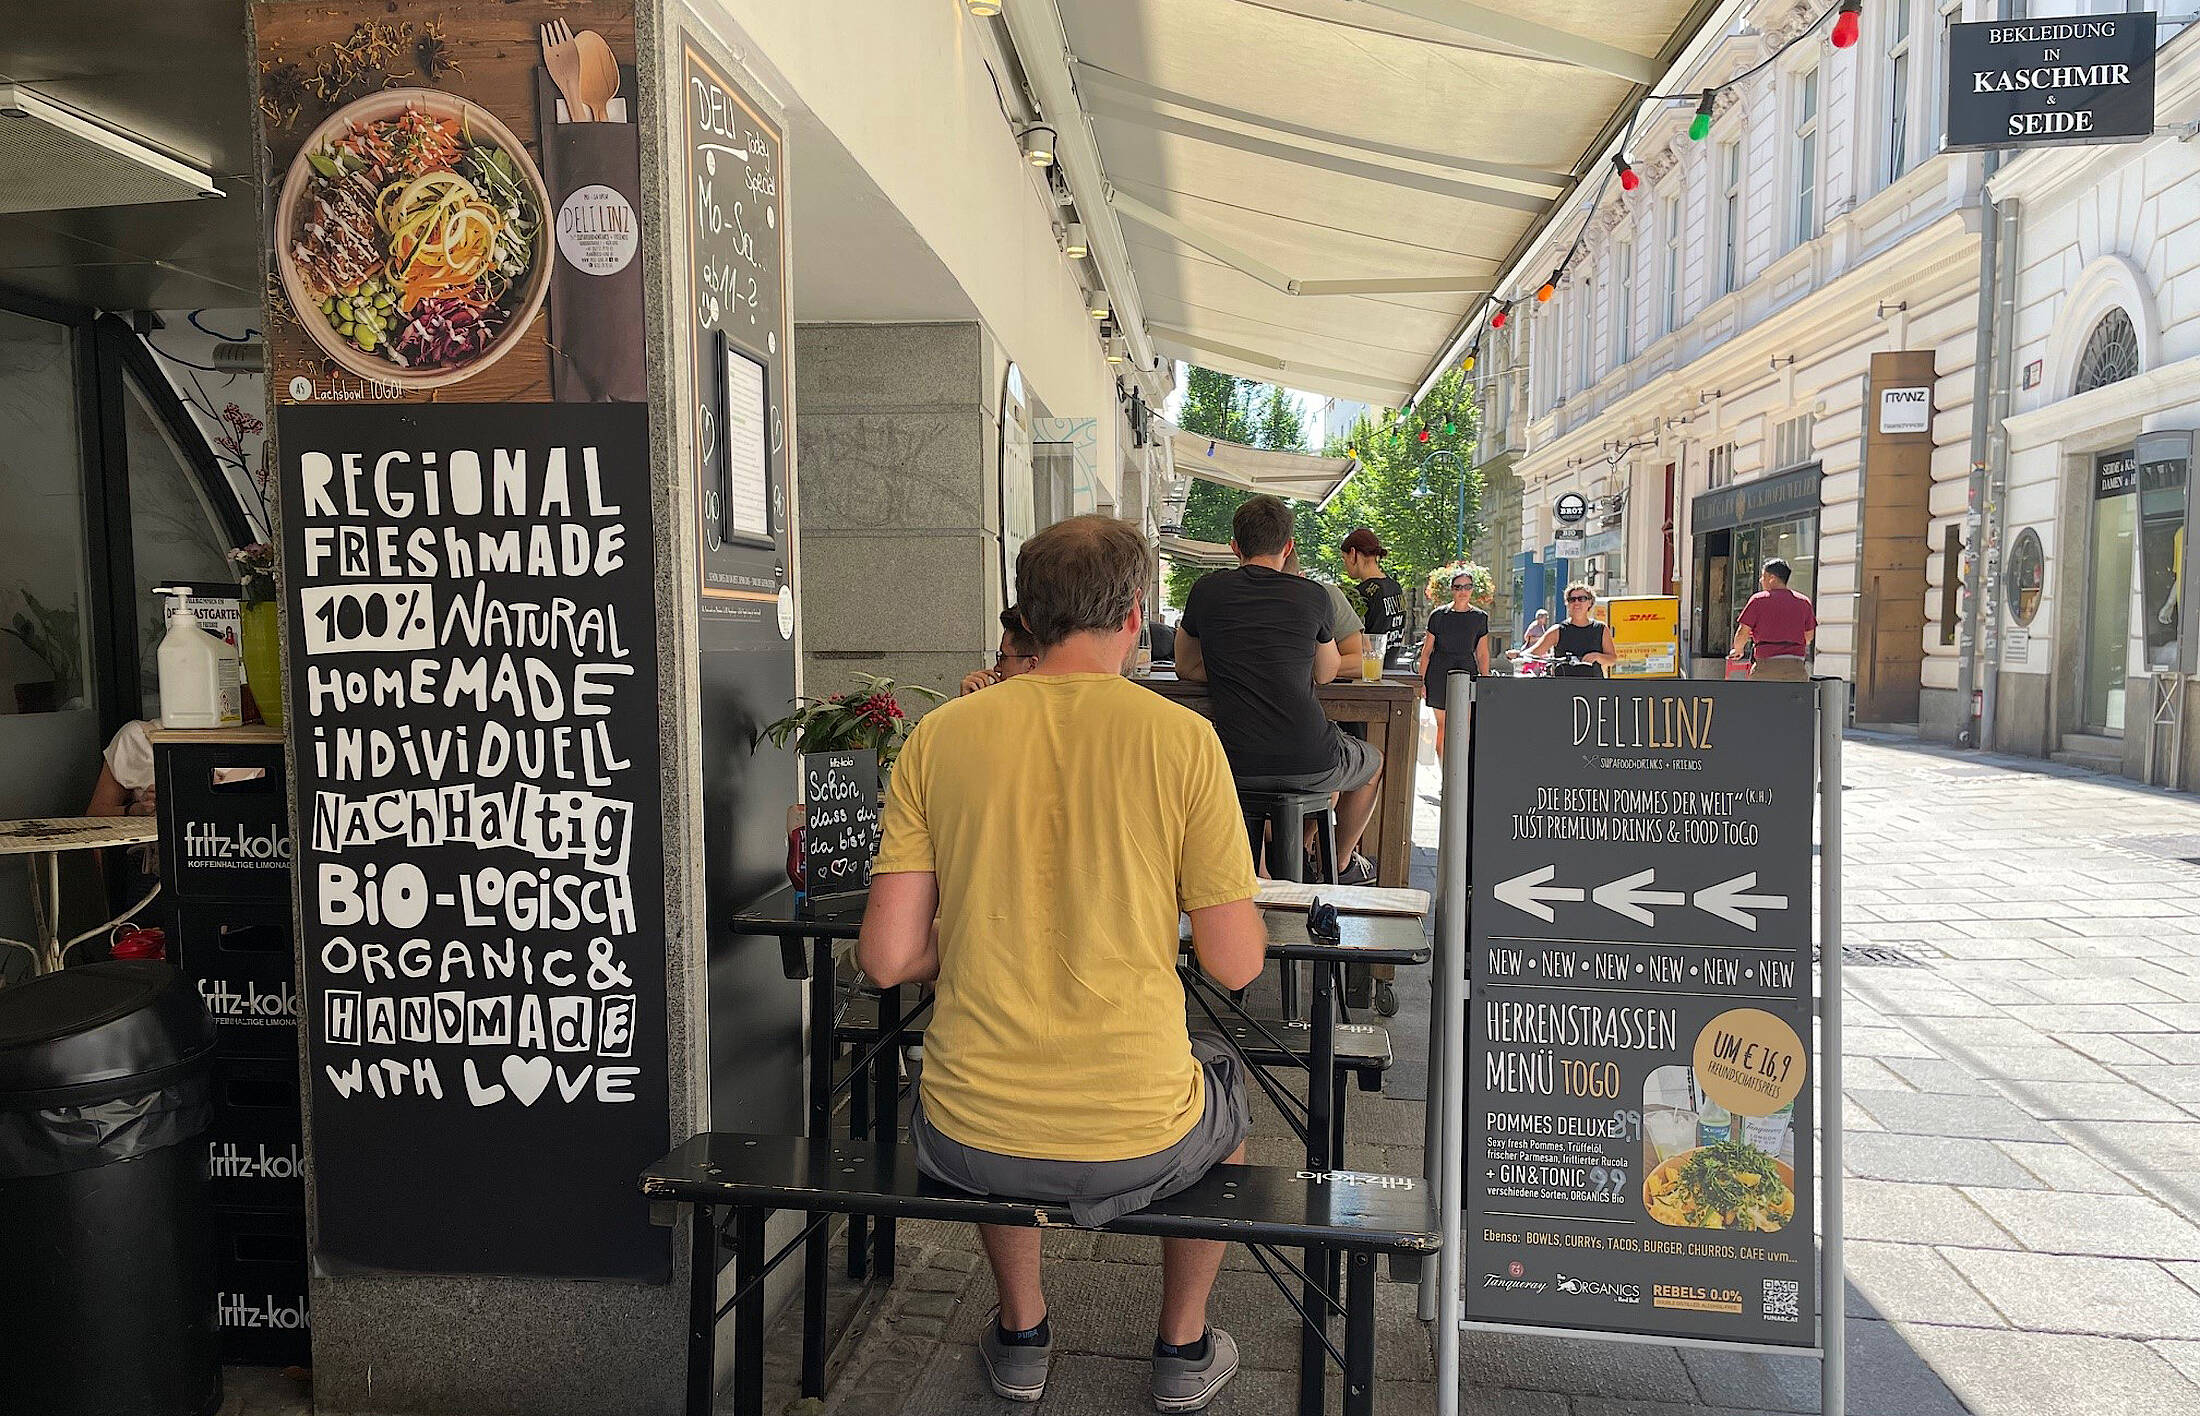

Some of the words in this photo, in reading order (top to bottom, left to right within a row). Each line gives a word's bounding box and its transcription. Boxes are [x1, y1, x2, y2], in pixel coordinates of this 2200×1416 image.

[1989, 22, 2115, 44] BEKLEIDUNG
[2043, 48, 2060, 61] IN
[1973, 64, 2130, 93] KASCHMIR
[691, 77, 736, 140] DELI
[2046, 95, 2057, 105] &
[2008, 110, 2094, 136] SEIDE
[313, 379, 364, 400] Lachsbowl
[190, 608, 240, 619] ASTGARTEN
[314, 588, 427, 644] 100%
[1673, 759, 1702, 770] FRIENDS
[810, 769, 865, 803] Schön,
[1564, 788, 1609, 813] BESTEN
[1614, 789, 1668, 815] POMMES
[1673, 791, 1697, 816] DER
[810, 807, 847, 829] dass
[857, 806, 876, 822] du
[1512, 814, 1542, 841] JUST
[1547, 815, 1608, 841] PREMIUM
[1613, 818, 1662, 843] DRINKS
[1667, 820, 1680, 843] &
[1684, 820, 1719, 844] FOOD
[811, 837, 834, 855] da
[840, 827, 866, 850] bist
[256, 861, 293, 869] LIMONAD
[1488, 949, 1522, 976] NEW
[1541, 951, 1576, 978] NEW
[1595, 953, 1630, 981] NEW
[1649, 955, 1684, 983] NEW
[1704, 957, 1739, 986] NEW
[1759, 960, 1795, 988] NEW
[1486, 1001, 1676, 1051] HERRENSTRASSEN
[1713, 1030, 1743, 1065] UM
[1744, 1043, 1759, 1070] €
[1758, 1047, 1792, 1083] 16,9
[1486, 1049, 1554, 1095] MENÜ
[1560, 1060, 1620, 1099] TOGO
[1486, 1112, 1552, 1135] POMMES
[1558, 1116, 1615, 1139] DELUXE
[1487, 1137, 1506, 1149] Sexy
[1508, 1138, 1528, 1149] fresh
[1530, 1140, 1566, 1152] Pommes,
[1487, 1149, 1517, 1161] frischer
[1520, 1151, 1561, 1164] Parmesan,
[1563, 1153, 1599, 1166] frittierter
[1602, 1156, 1628, 1168] Rucola
[1485, 1169, 1496, 1179] +
[1500, 1164, 1586, 1188] GIN&TONIC
[1487, 1186, 1539, 1198] verschiedene
[1540, 1189, 1569, 1201] Sorten,
[1571, 1190, 1610, 1203] ORGANICS
[1611, 1194, 1625, 1204] Bio
[1483, 1228, 1521, 1243] Ebenso:
[1526, 1231, 1562, 1247] BOWLS,
[1565, 1234, 1605, 1250] CURRYs,
[1607, 1237, 1641, 1252] TACOS,
[1644, 1239, 1685, 1256] BURGER,
[1688, 1243, 1737, 1260] CHURROS,
[1740, 1247, 1764, 1261] CAFE
[1483, 1273, 1548, 1294] Tanqueray
[1568, 1278, 1640, 1298] ORGANICS
[1653, 1284, 1706, 1300] REBELS
[1710, 1288, 1742, 1302] 0.0%
[218, 1292, 311, 1328] fritz-kol
